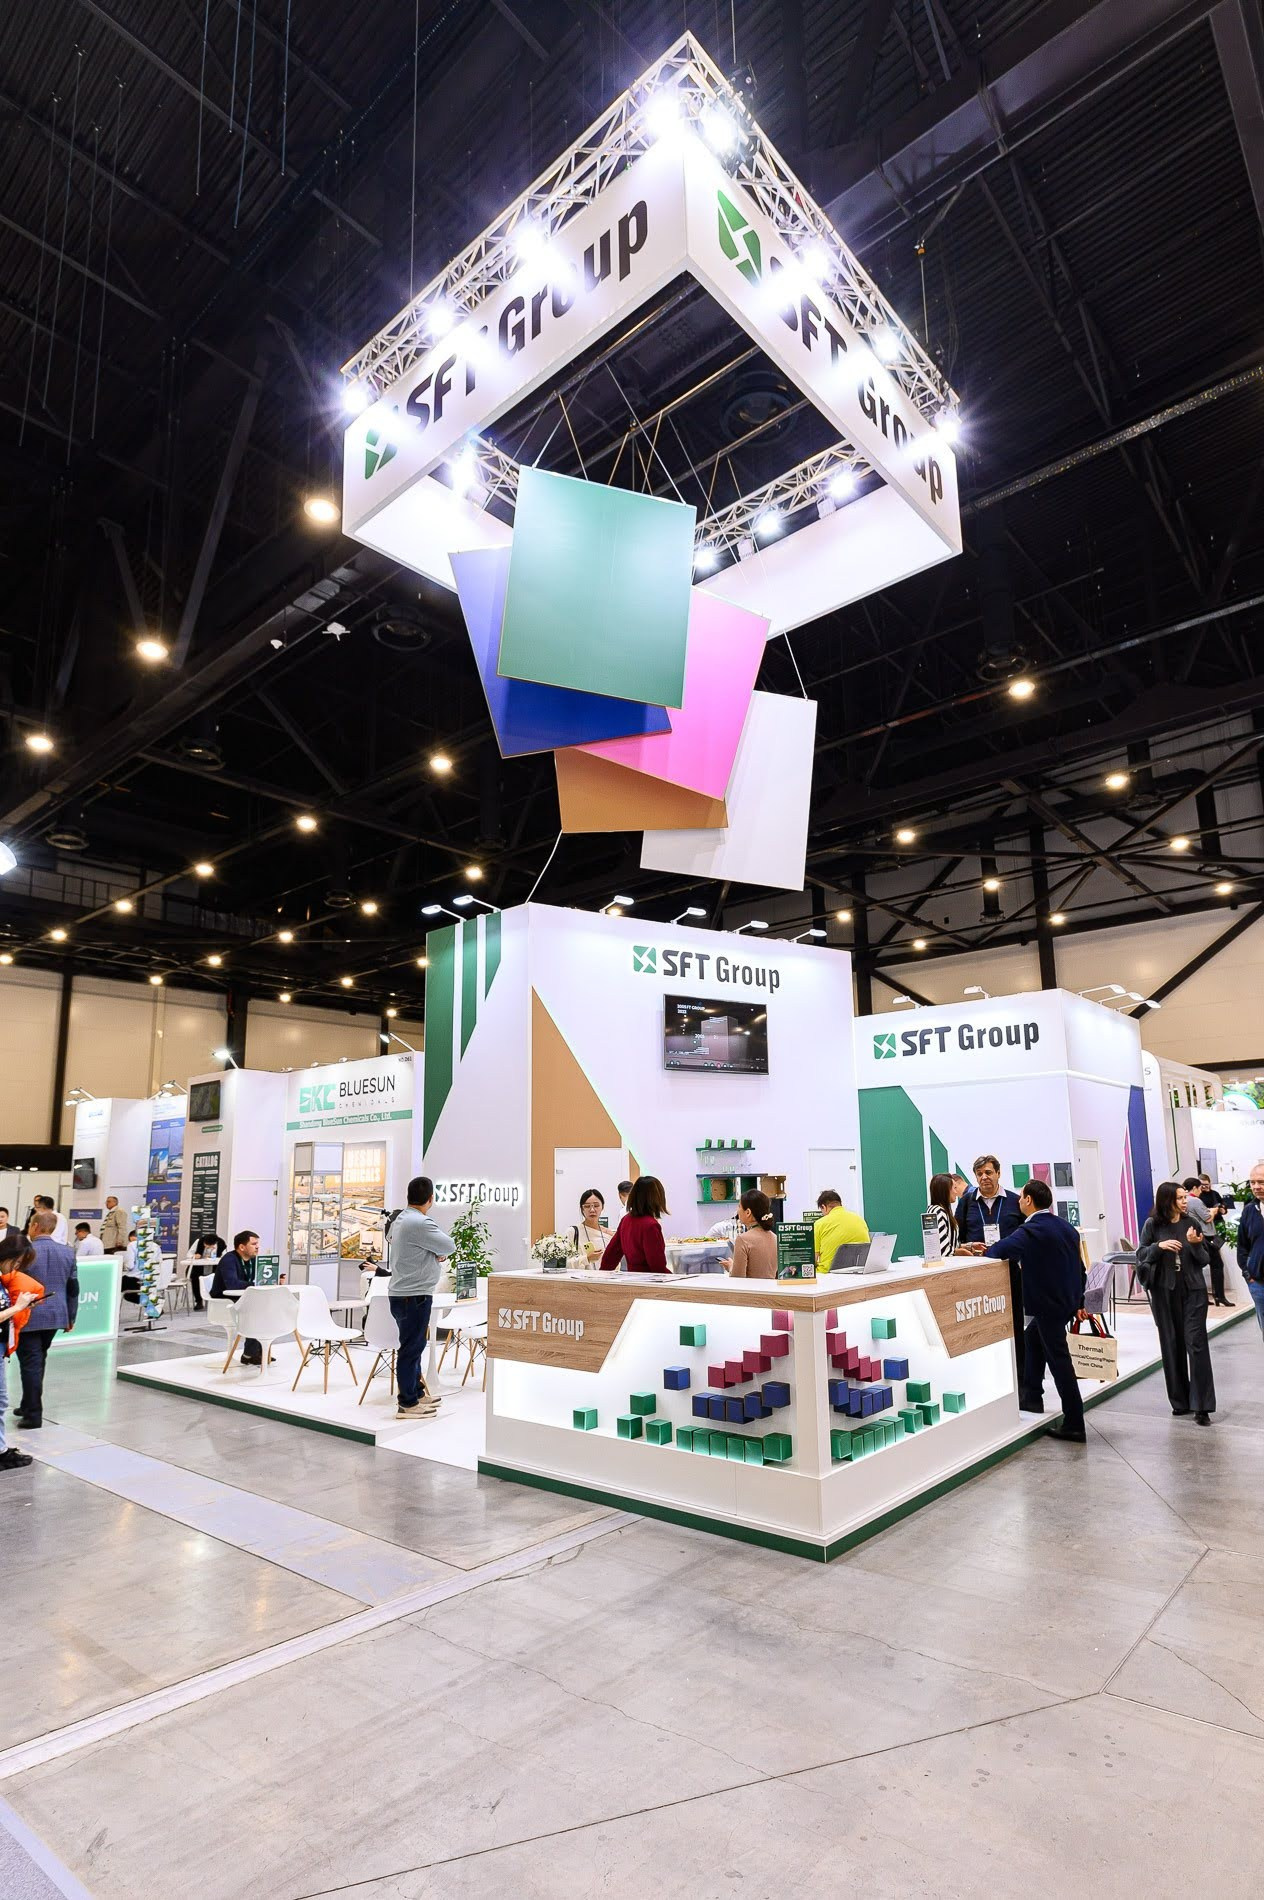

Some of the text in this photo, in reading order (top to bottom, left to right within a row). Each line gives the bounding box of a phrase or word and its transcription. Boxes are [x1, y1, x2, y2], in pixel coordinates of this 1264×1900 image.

[662, 949, 780, 994] SFT Group
[901, 1022, 1039, 1056] SFT Group
[339, 1075, 395, 1097] BLUESUN
[449, 1183, 519, 1207] SFT Group
[1071, 1209, 1077, 1220] 2
[796, 1224, 813, 1232] Group
[263, 1265, 273, 1278] 5
[965, 1294, 1006, 1320] SFT Group
[512, 1309, 584, 1341] SFT Group
[1078, 1344, 1104, 1354] Thermal
